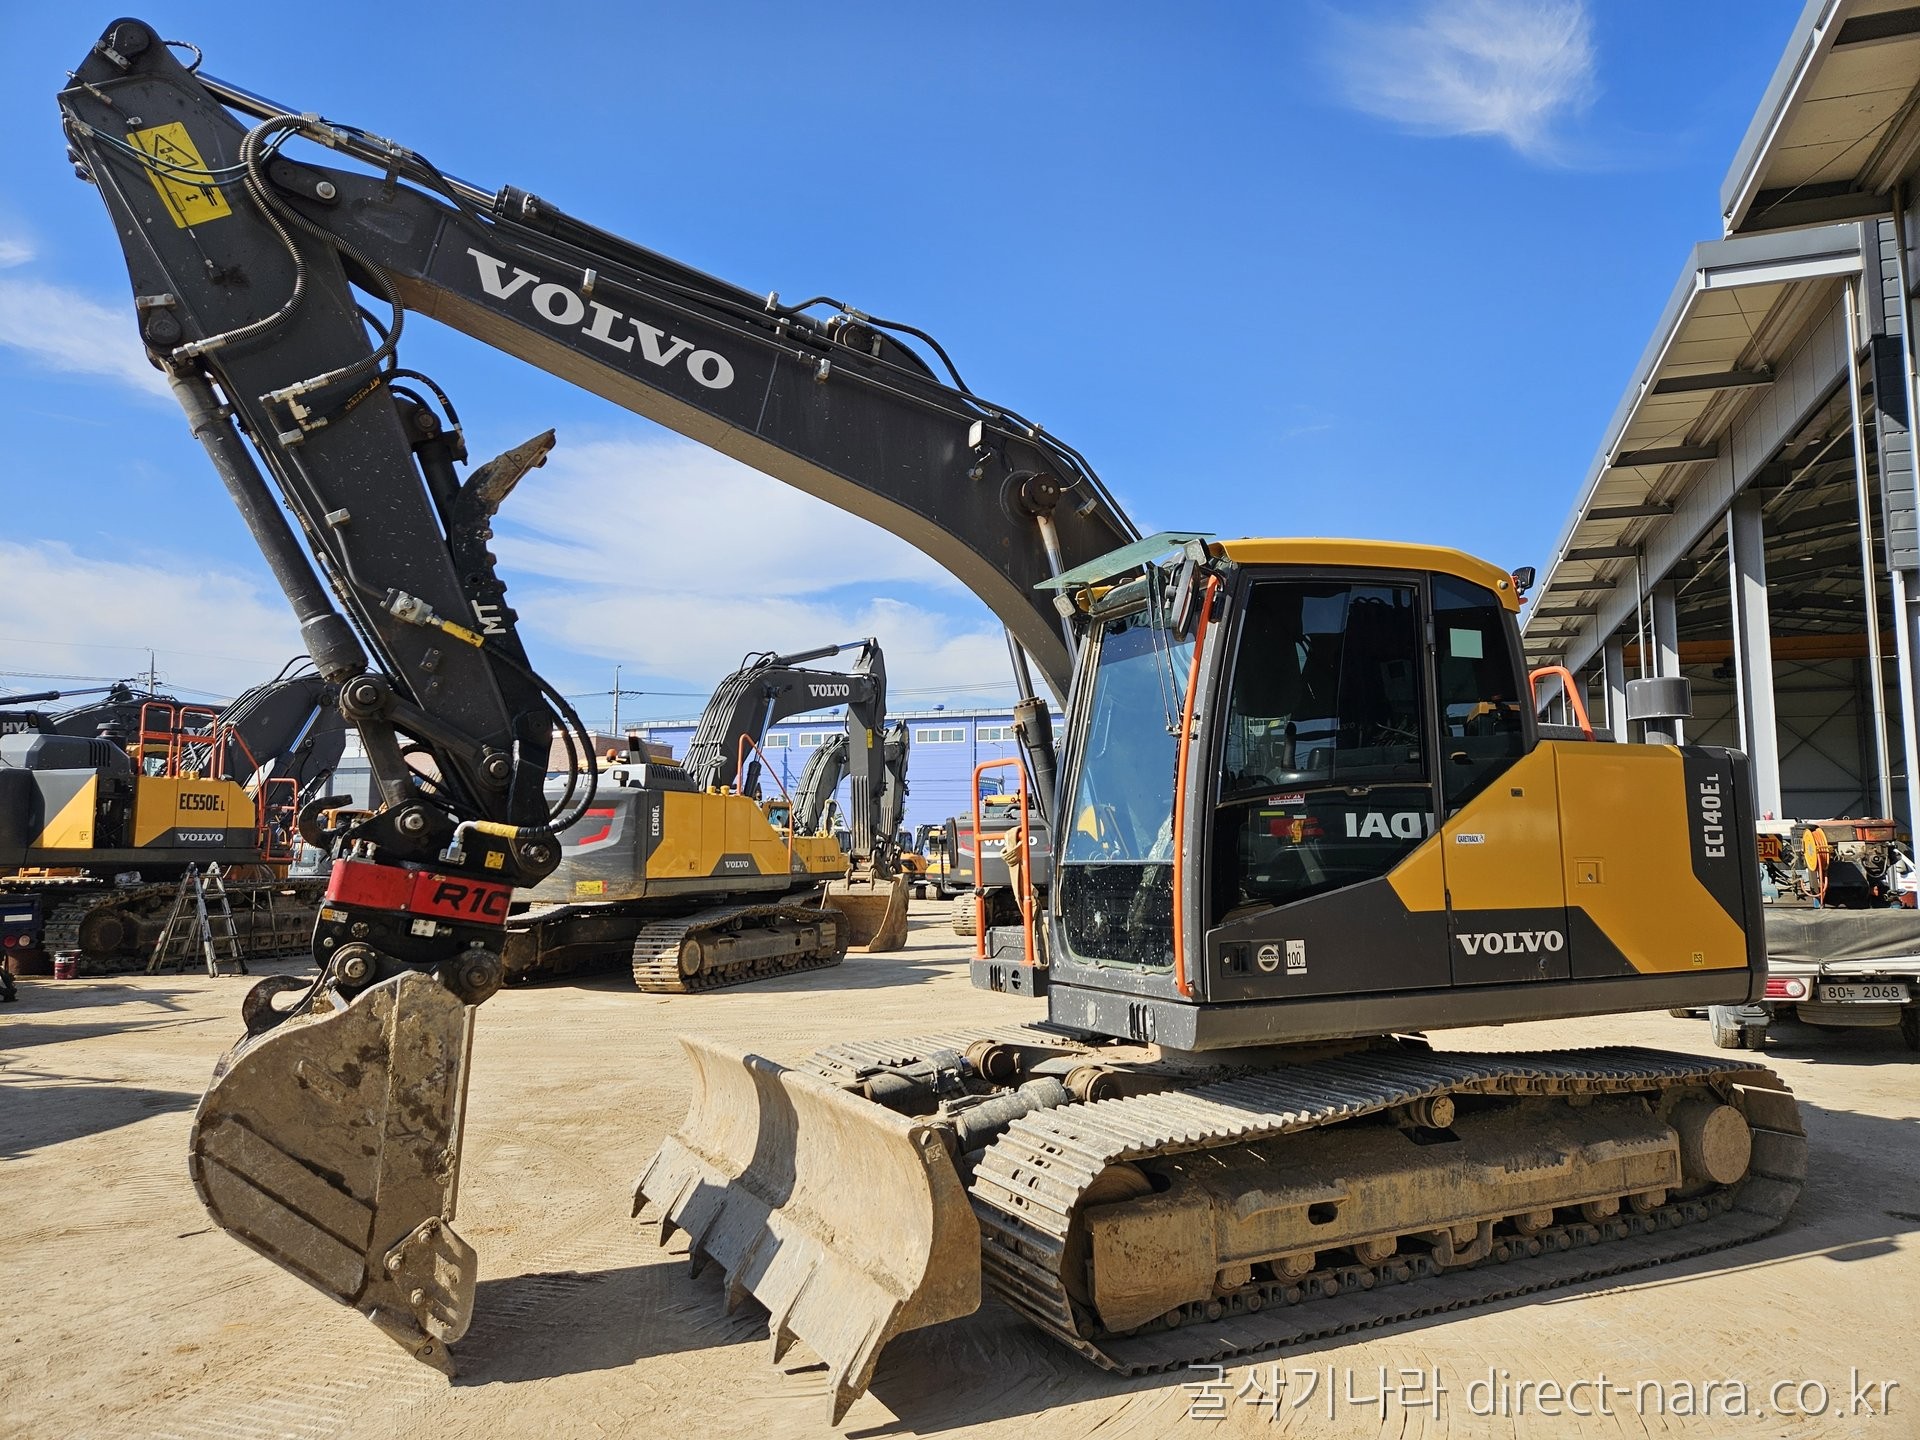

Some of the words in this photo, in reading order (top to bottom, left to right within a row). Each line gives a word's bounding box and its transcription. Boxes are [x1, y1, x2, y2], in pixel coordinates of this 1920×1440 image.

[467, 247, 735, 389] VOLVO
[471, 599, 507, 635] MT
[808, 684, 850, 697] VOLVO
[178, 833, 224, 842] VOLVO
[725, 860, 749, 868] VOLVO
[1456, 930, 1564, 956] VOLVO
[1287, 951, 1301, 966] 100
[1862, 986, 1899, 998] 2068
